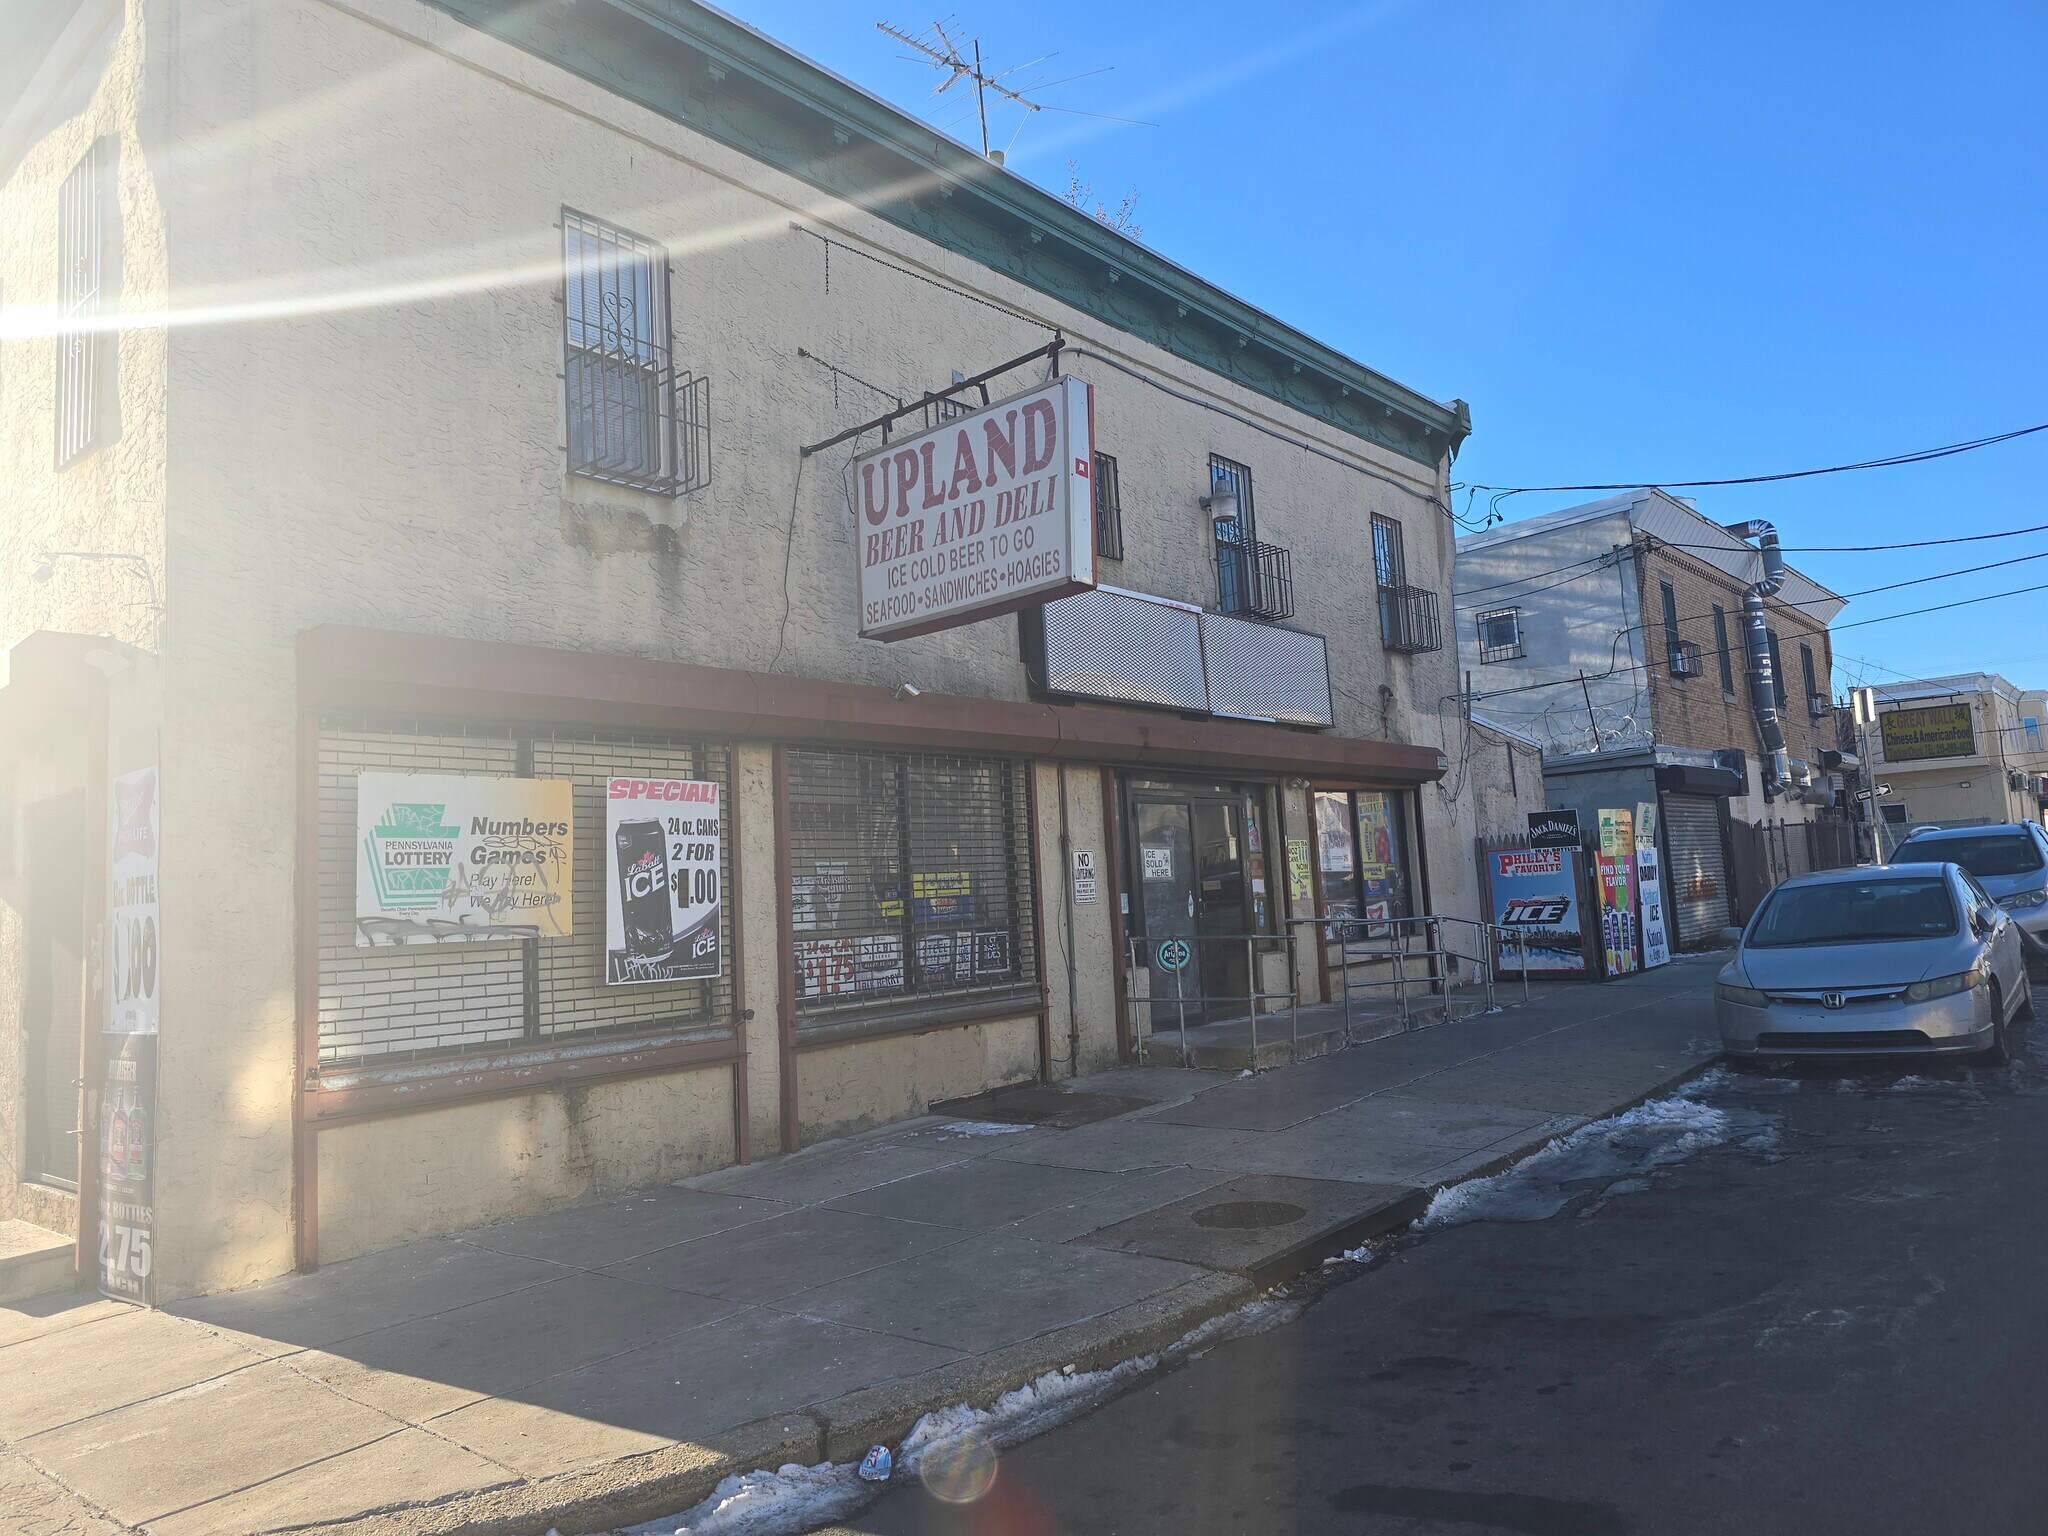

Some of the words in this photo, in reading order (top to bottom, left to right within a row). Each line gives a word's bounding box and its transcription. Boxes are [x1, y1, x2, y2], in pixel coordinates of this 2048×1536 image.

[861, 398, 1058, 527] UPLAND
[864, 518, 925, 568] BEER
[932, 500, 986, 548] AND
[993, 474, 1059, 529] DELI
[887, 563, 907, 590] ICE
[911, 552, 946, 583] COLD
[950, 542, 985, 573] BEER
[990, 533, 1009, 560] TO
[1013, 525, 1035, 553] GO
[866, 590, 916, 626] SEAFOOD
[924, 569, 999, 610] SANDWICHES
[1007, 549, 1061, 588] HOAGIES
[1897, 712, 1926, 729] GREAT
[1930, 709, 1954, 725] WALL
[608, 778, 719, 804] SPECIAL!
[133, 826, 149, 840] LIFE
[470, 816, 568, 836] Numbers
[668, 817, 680, 835] 24
[696, 819, 719, 837] CANS
[1530, 824, 1548, 839] JACK
[1547, 820, 1578, 836] DANIEL'S
[385, 841, 454, 850] PENNSYLVANIA
[470, 845, 547, 865] Games
[671, 843, 684, 861] 2
[686, 843, 715, 861] FOR
[1145, 850, 1156, 859] ICE
[385, 851, 453, 866] LOTTERY
[627, 854, 662, 876] Labatt
[1077, 853, 1090, 867] NO
[1146, 859, 1163, 868] SOLD
[1499, 851, 1561, 875] PHILLY'S
[1151, 869, 1169, 877] HERE
[1514, 863, 1562, 874] FAVORITE
[1600, 865, 1614, 875] FIND
[1615, 864, 1631, 875] YOUR
[1640, 865, 1657, 881] DADDY
[501, 872, 537, 887] Here!
[624, 863, 665, 902] ICE
[1605, 877, 1627, 887] FLAVOR
[126, 874, 157, 907] BOTTLE
[470, 895, 491, 908] We
[1506, 904, 1564, 921] ICE
[1650, 904, 1660, 922] ICE
[1646, 927, 1664, 948] Natural
[692, 936, 716, 959] ICE
[806, 942, 818, 955] 24
[806, 956, 855, 995] $1.75
[112, 1201, 153, 1225] BOTTLES
[100, 1270, 139, 1294] EACH
